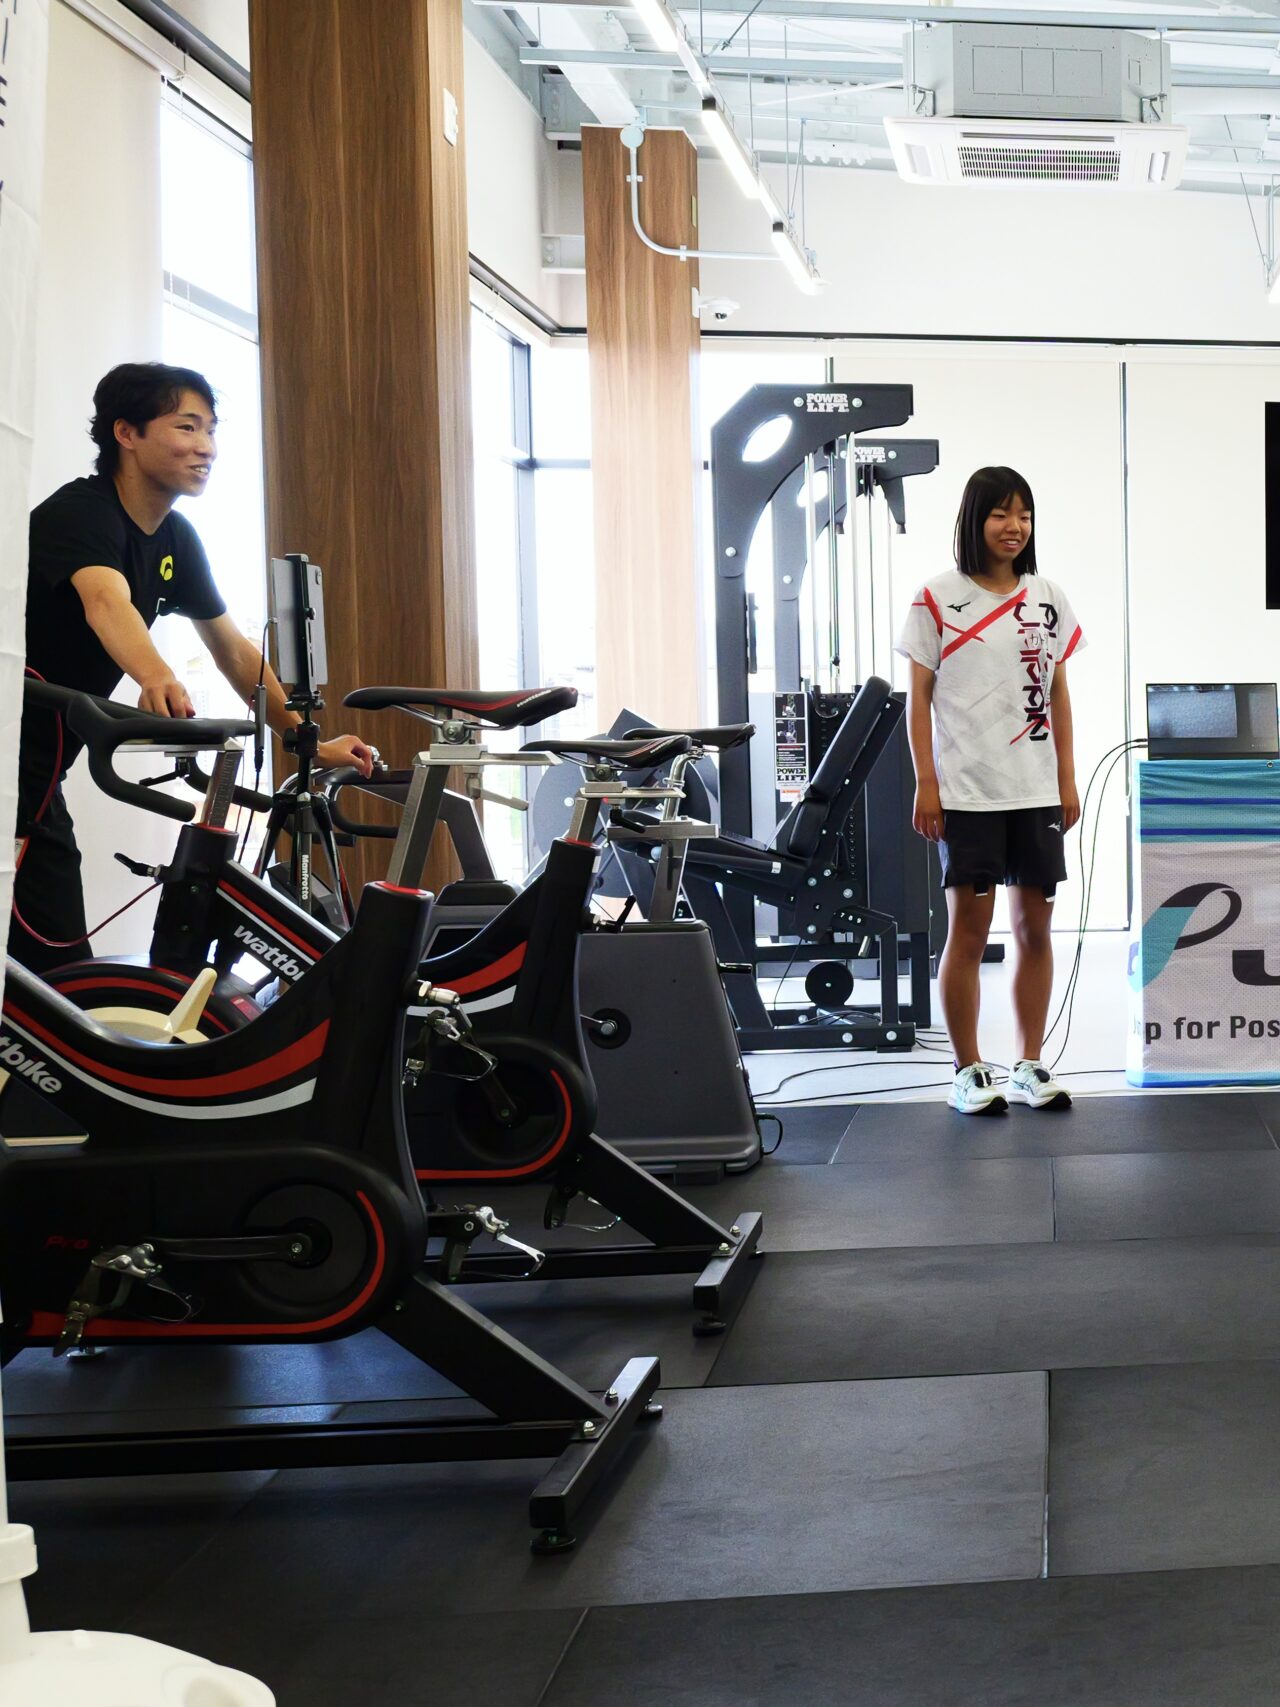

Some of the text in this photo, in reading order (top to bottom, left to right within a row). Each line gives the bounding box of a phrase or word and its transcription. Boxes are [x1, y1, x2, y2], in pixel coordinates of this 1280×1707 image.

[806, 393, 849, 404] POWER
[855, 447, 885, 456] OWER
[301, 854, 311, 900] Manfrotto
[1173, 1016, 1220, 1040] for
